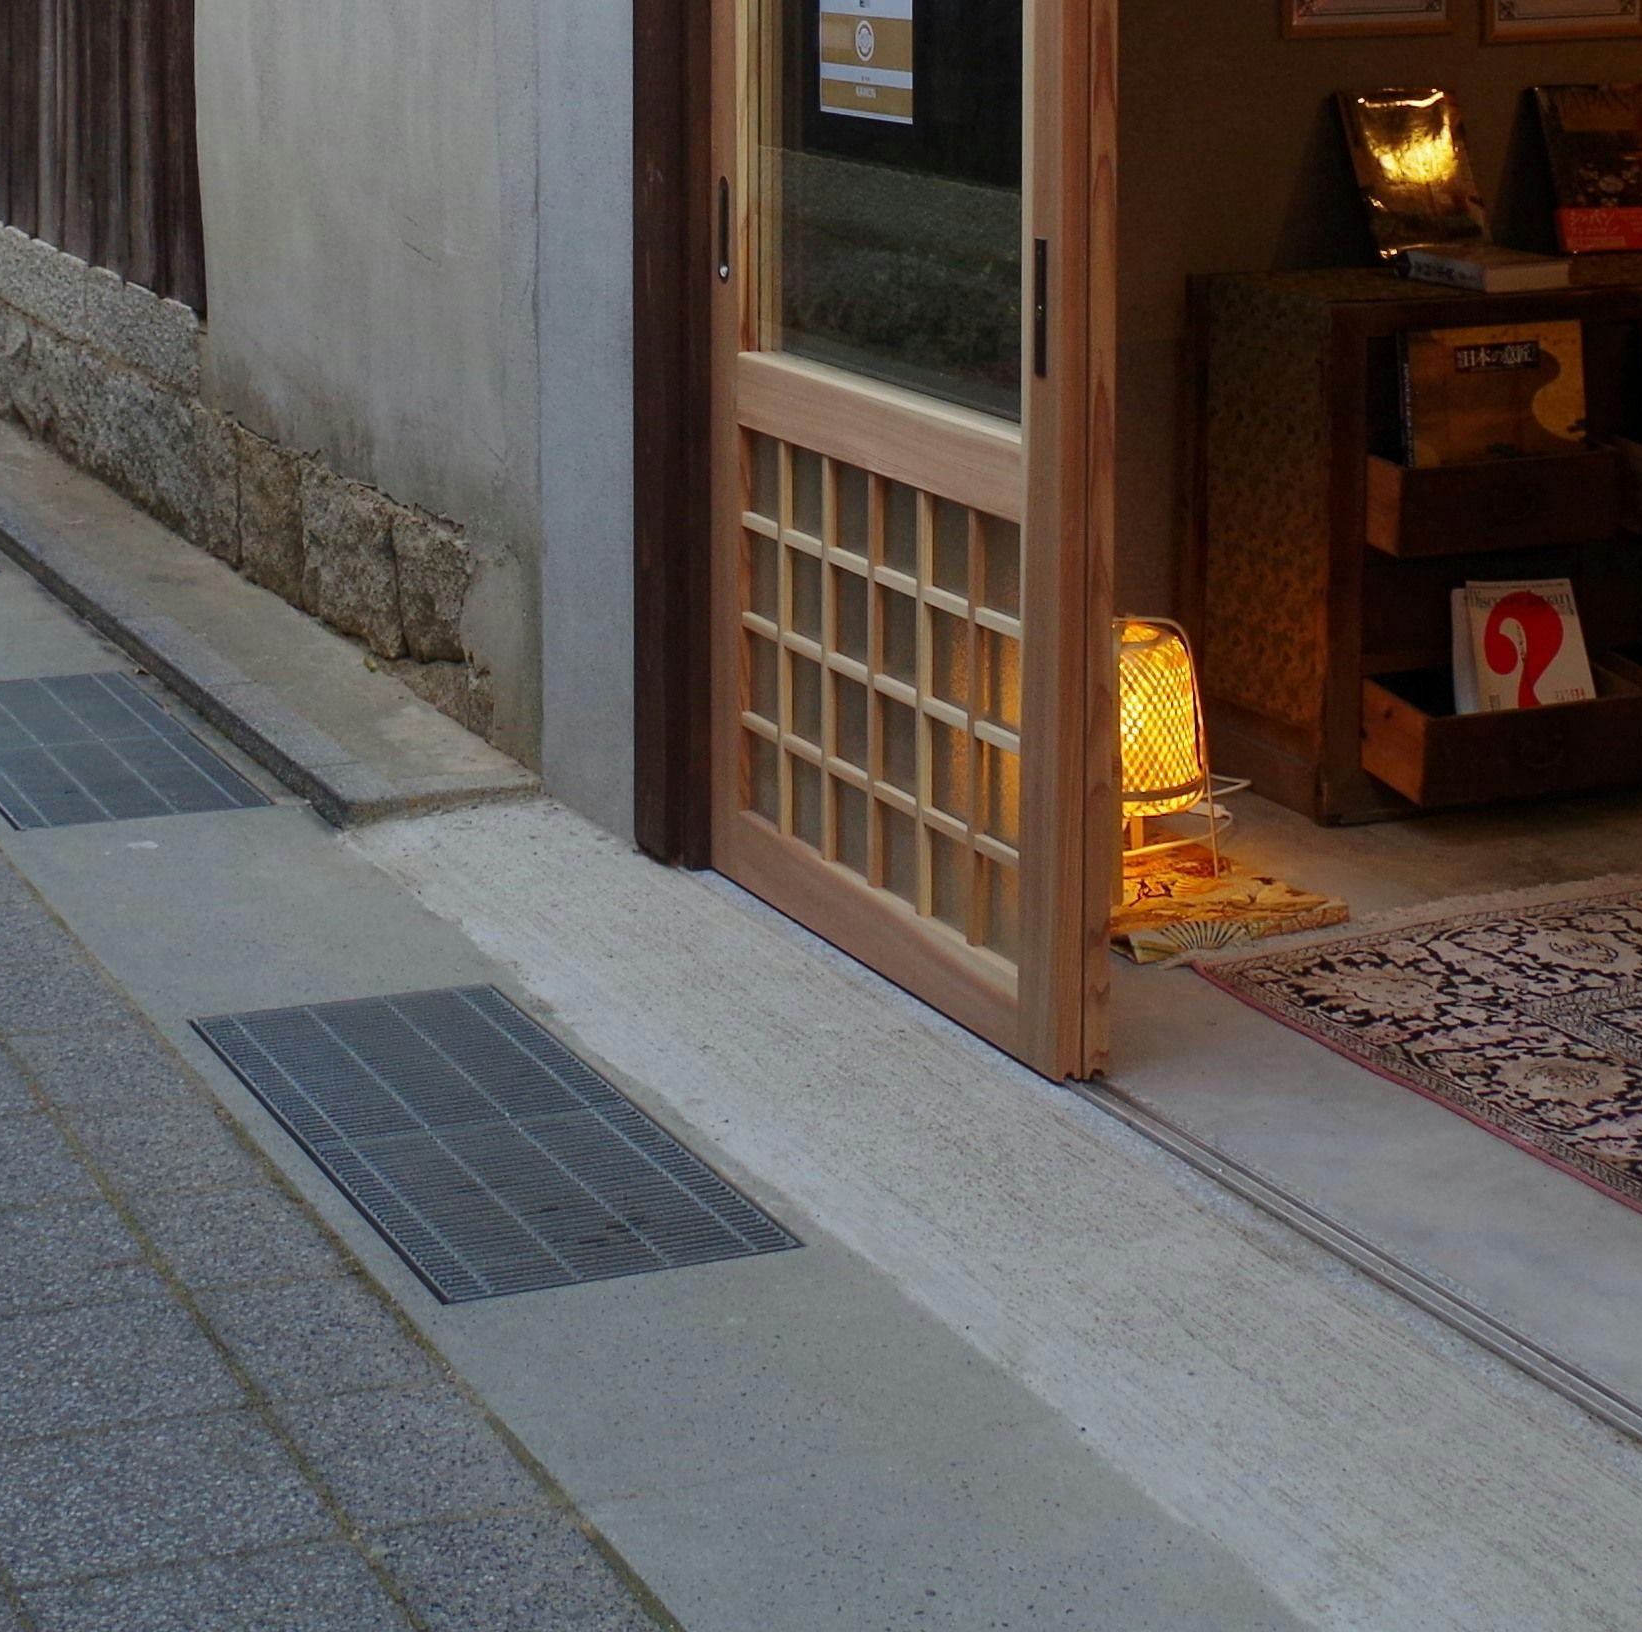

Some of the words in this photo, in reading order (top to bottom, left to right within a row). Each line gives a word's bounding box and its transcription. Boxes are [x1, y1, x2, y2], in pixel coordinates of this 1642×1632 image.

[1463, 343, 1534, 368] 日本の意匠
